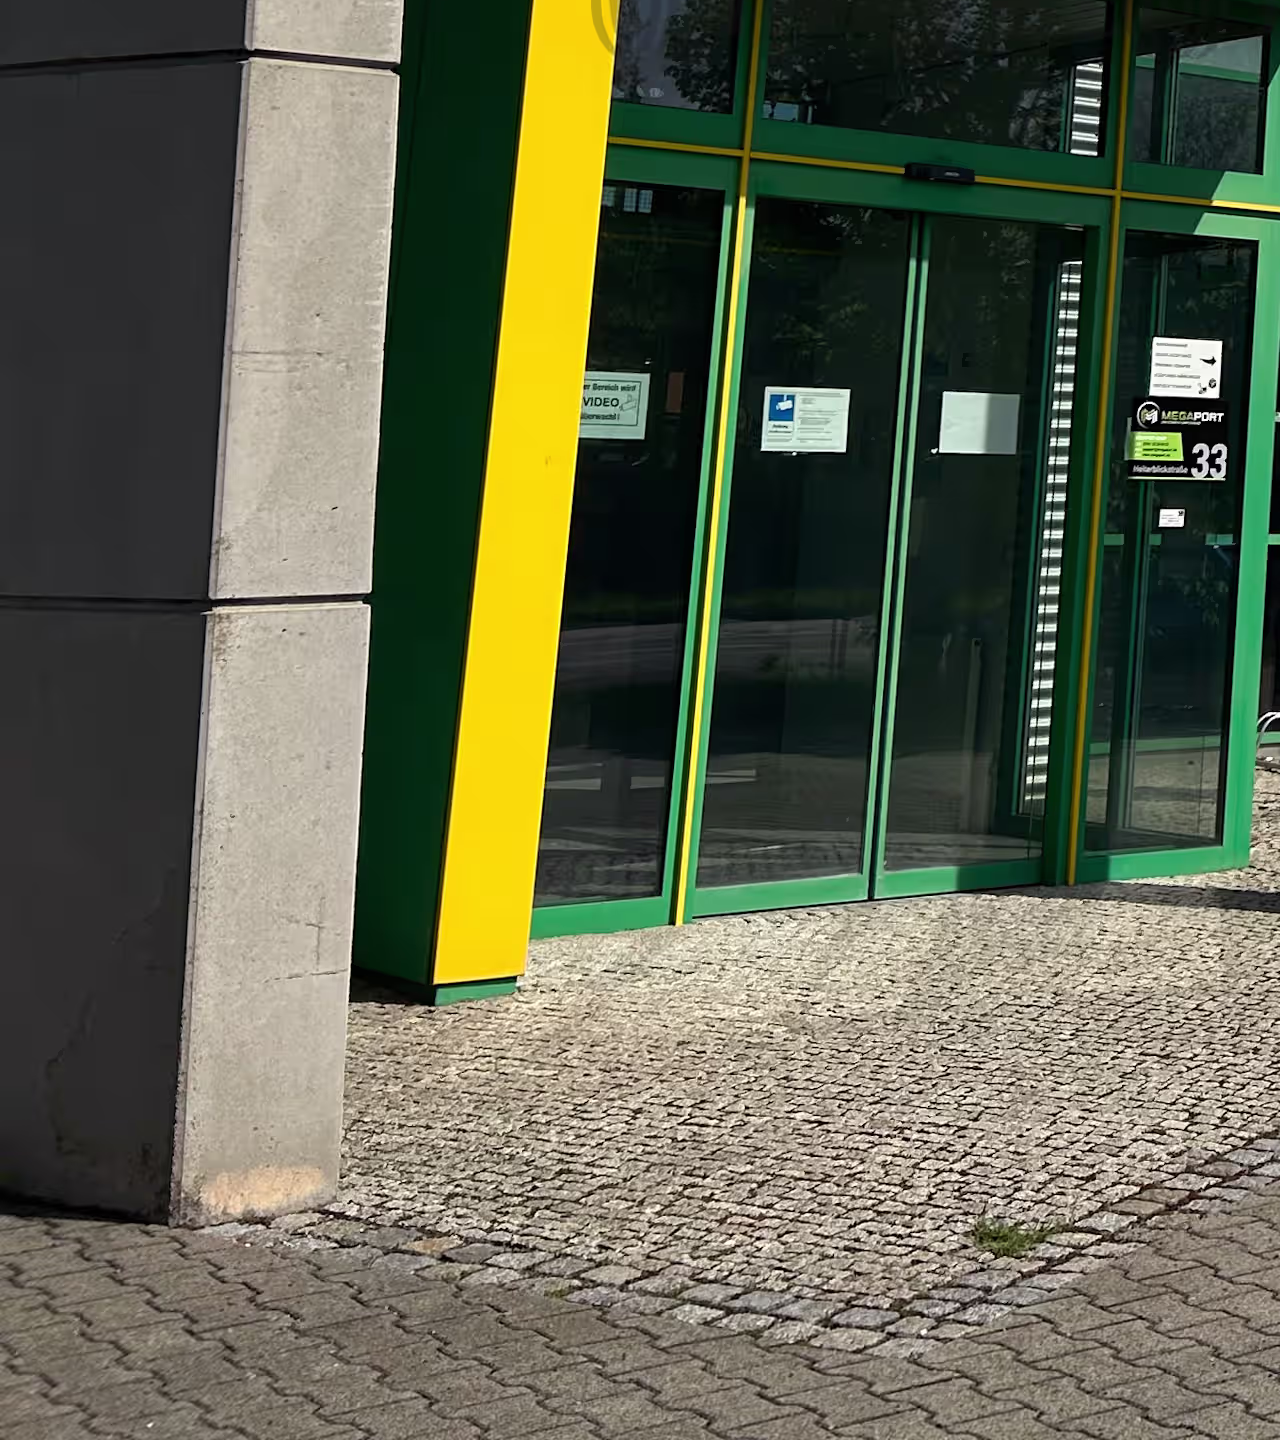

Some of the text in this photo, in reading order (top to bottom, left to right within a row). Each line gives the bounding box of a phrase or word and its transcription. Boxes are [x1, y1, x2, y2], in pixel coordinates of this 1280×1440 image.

[583, 397, 620, 408] VIDEO
[1161, 410, 1225, 422] MEGAPORT
[1190, 443, 1228, 479] 33
